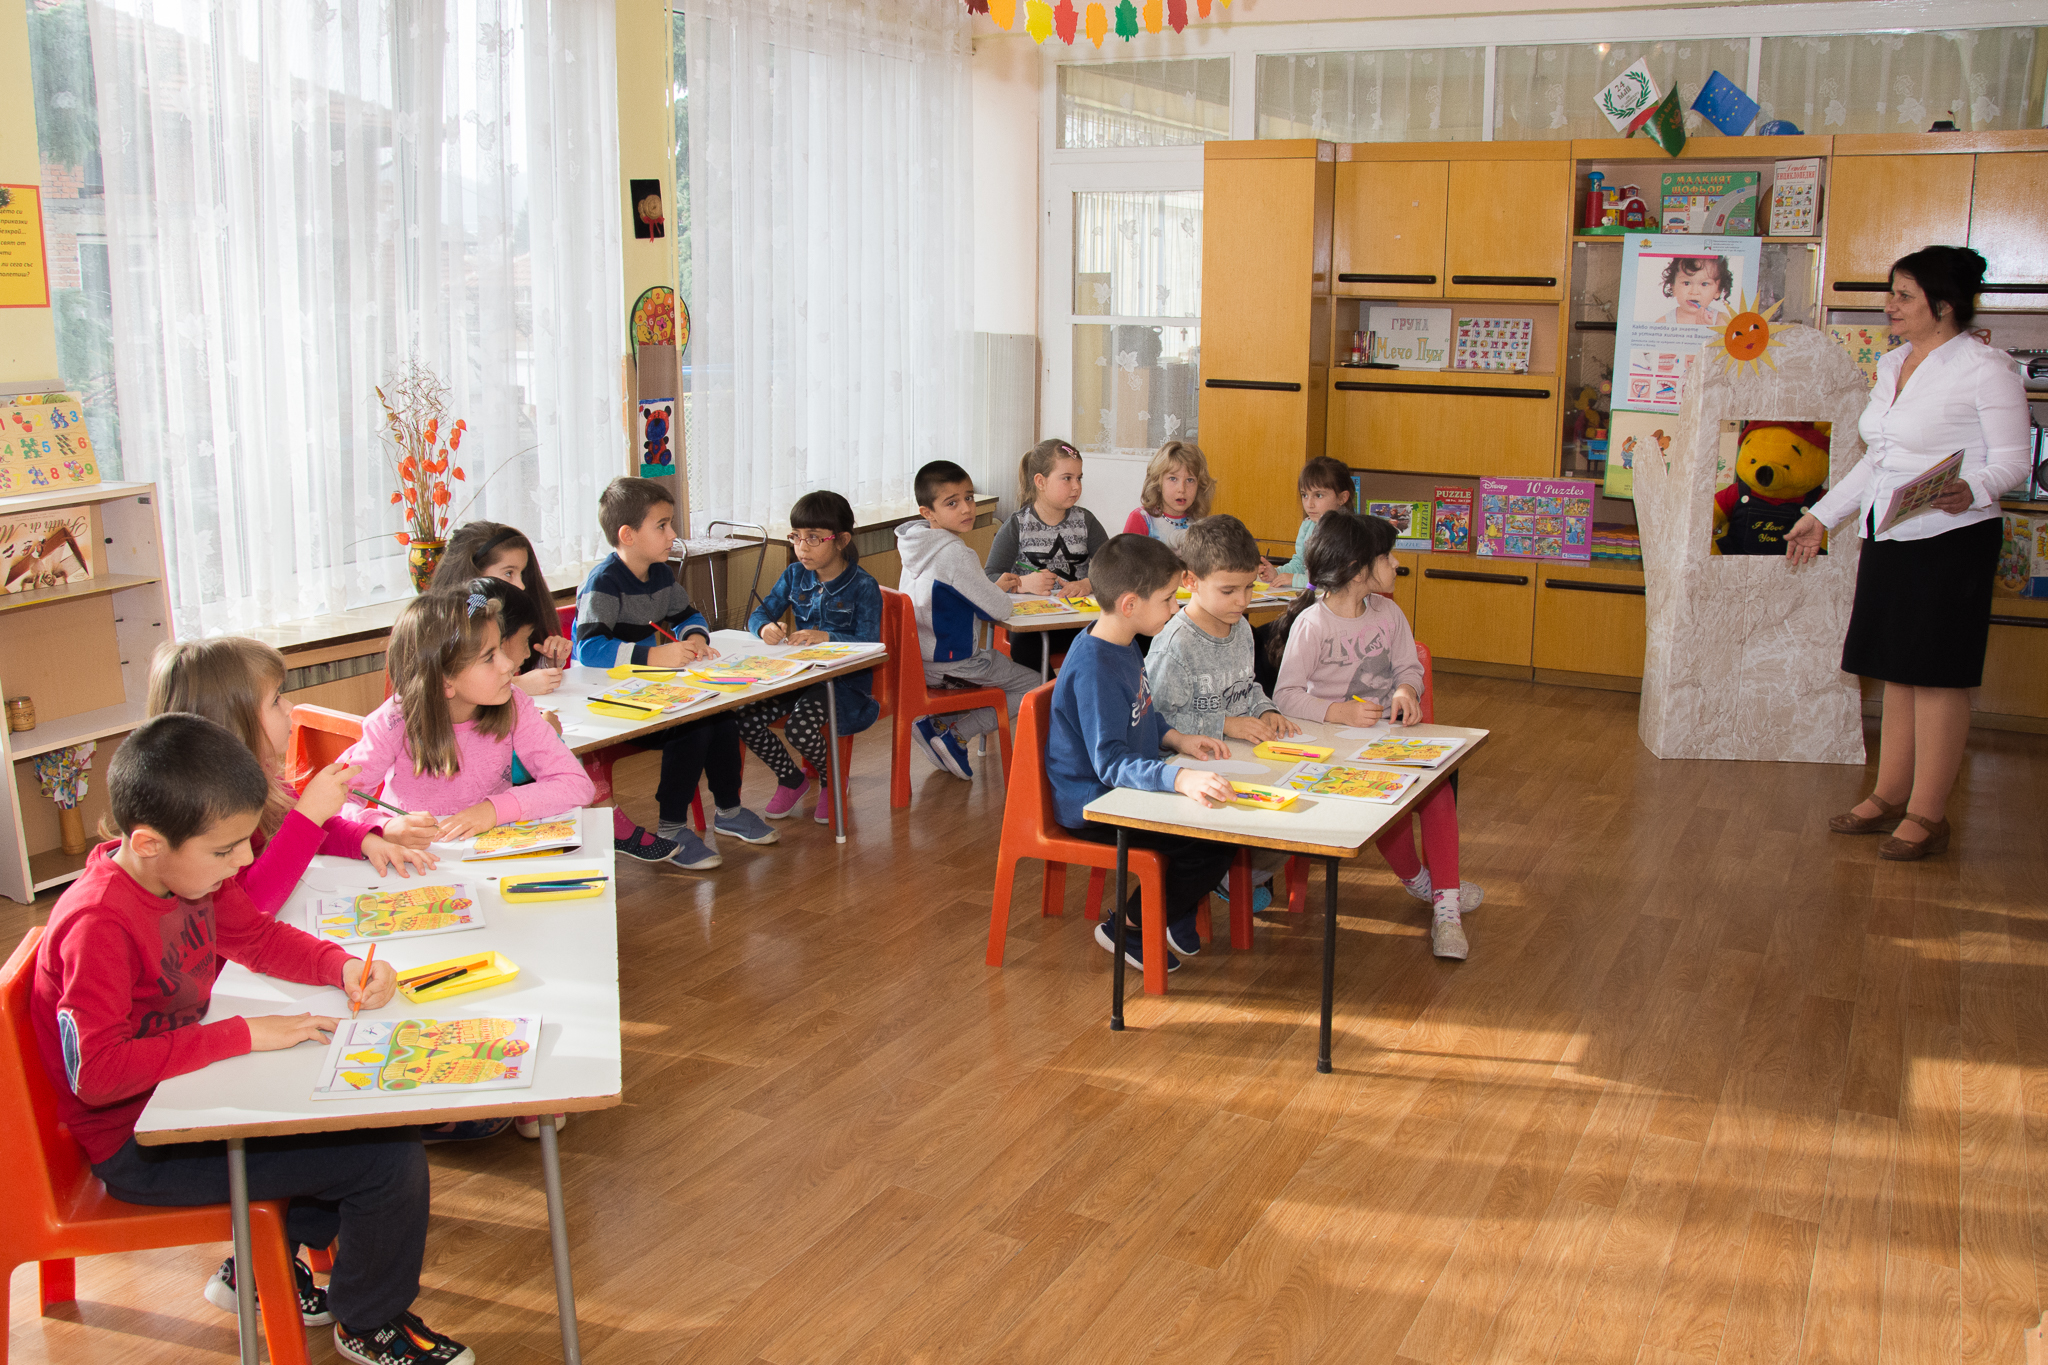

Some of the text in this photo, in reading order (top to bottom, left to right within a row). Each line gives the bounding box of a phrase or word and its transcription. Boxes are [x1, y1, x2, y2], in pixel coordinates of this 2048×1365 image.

[1676, 176, 1732, 185] МАЛКИЯТ
[1672, 186, 1724, 194] ШОФЬОР
[1391, 318, 1429, 331] ГРУПА
[660, 331, 668, 339] 10
[1846, 333, 1851, 341] 1
[1374, 337, 1412, 360] Мечо
[1874, 352, 1881, 361] 5
[34, 414, 43, 426] 2
[69, 410, 79, 422] 3
[42, 441, 51, 453] 5
[78, 437, 87, 449] 6
[4, 444, 13, 456] 4
[50, 467, 59, 480] 8
[84, 463, 93, 475] 9
[13, 474, 21, 485] 7
[1482, 480, 1508, 492] Disney
[1526, 482, 1584, 496] 10 Puzzles
[1436, 490, 1472, 499] PUZZLE
[1421, 504, 1429, 538] PUZZLE
[1763, 522, 1785, 531] Love
[1758, 533, 1778, 542] You
